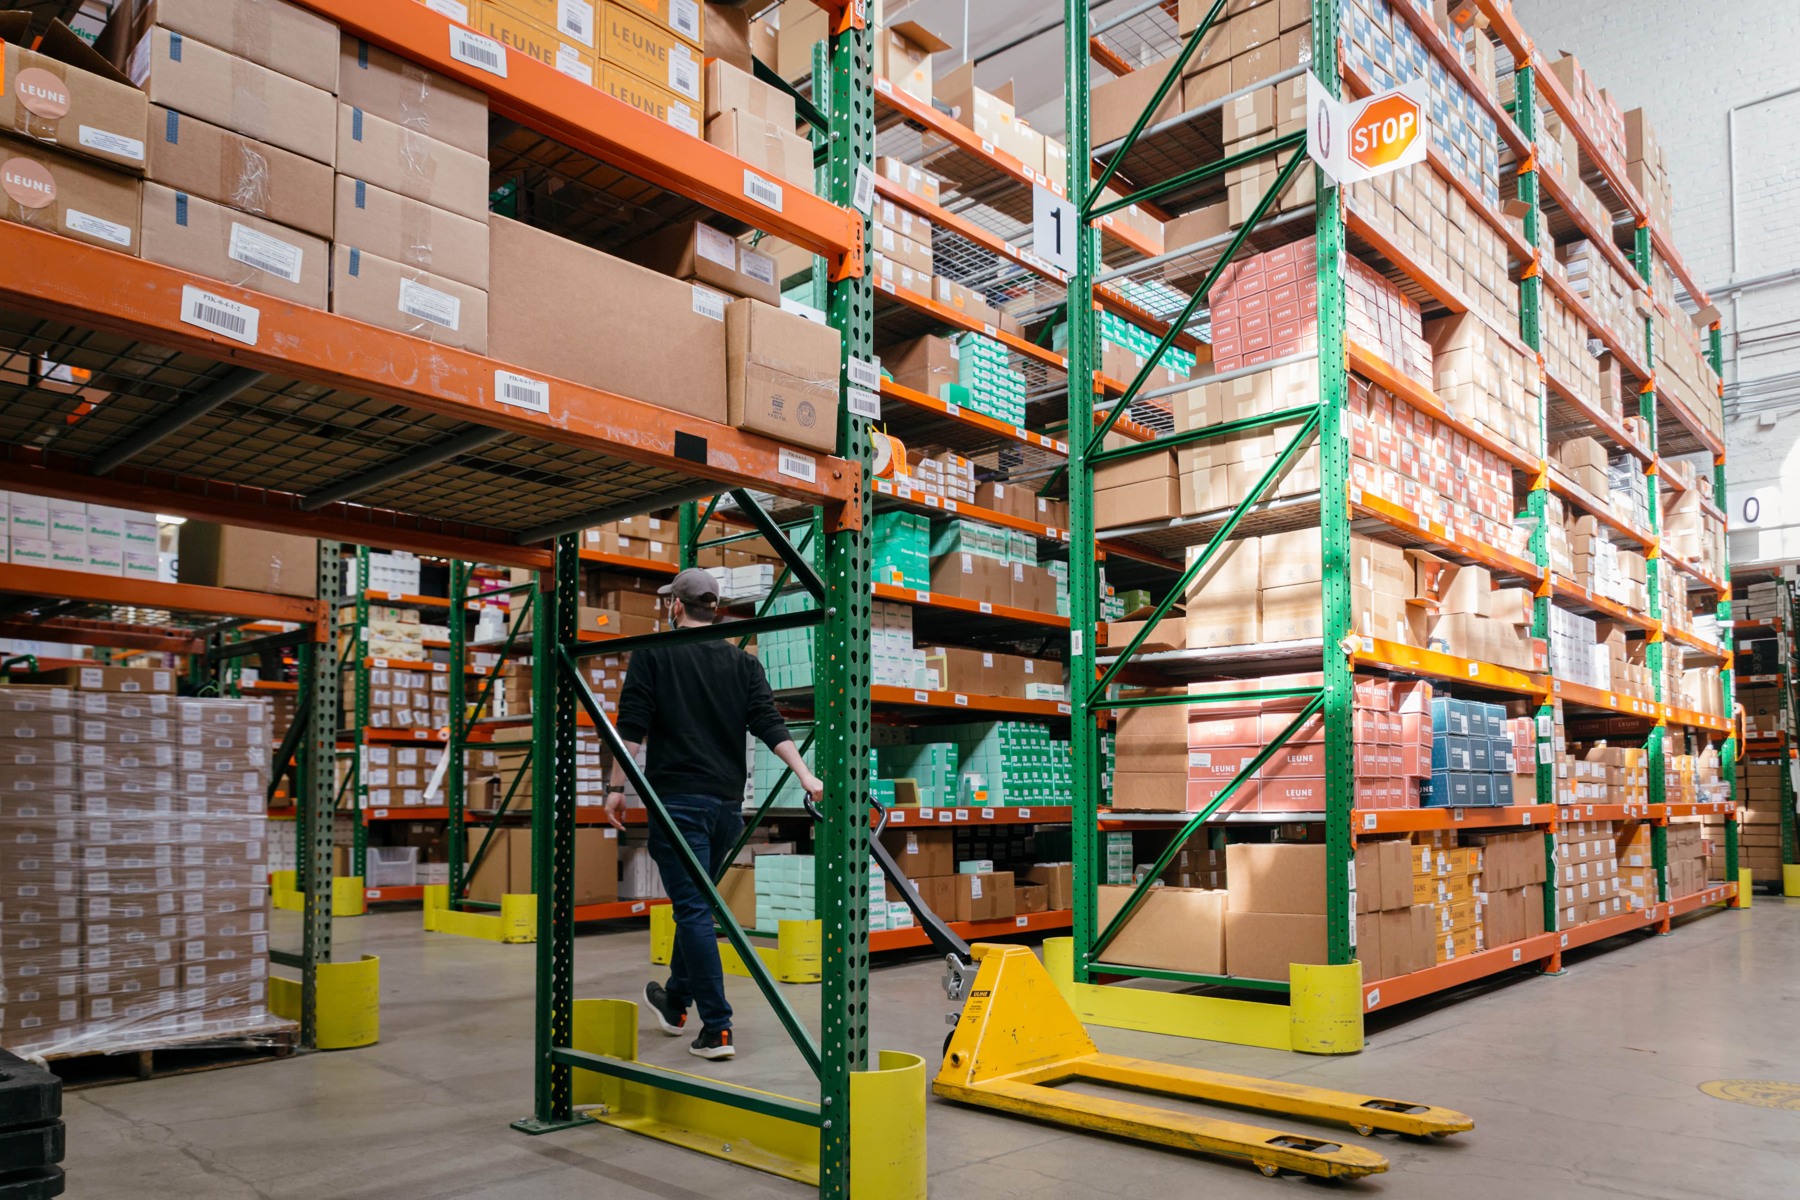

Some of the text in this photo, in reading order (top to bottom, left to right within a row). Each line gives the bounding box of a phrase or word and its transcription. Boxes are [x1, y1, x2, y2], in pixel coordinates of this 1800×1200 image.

[490, 22, 552, 66] LEUNE
[613, 21, 665, 62] LEUNE
[20, 82, 66, 105] LEUNE
[610, 82, 664, 120] LEUNE
[1318, 99, 1330, 159] 0
[1354, 112, 1414, 153] STOP
[5, 172, 52, 194] LEUNE
[1050, 207, 1061, 255] 1
[1743, 497, 1760, 523] 0
[1287, 754, 1313, 762] LEUNE
[890, 906, 909, 914] Buddies
